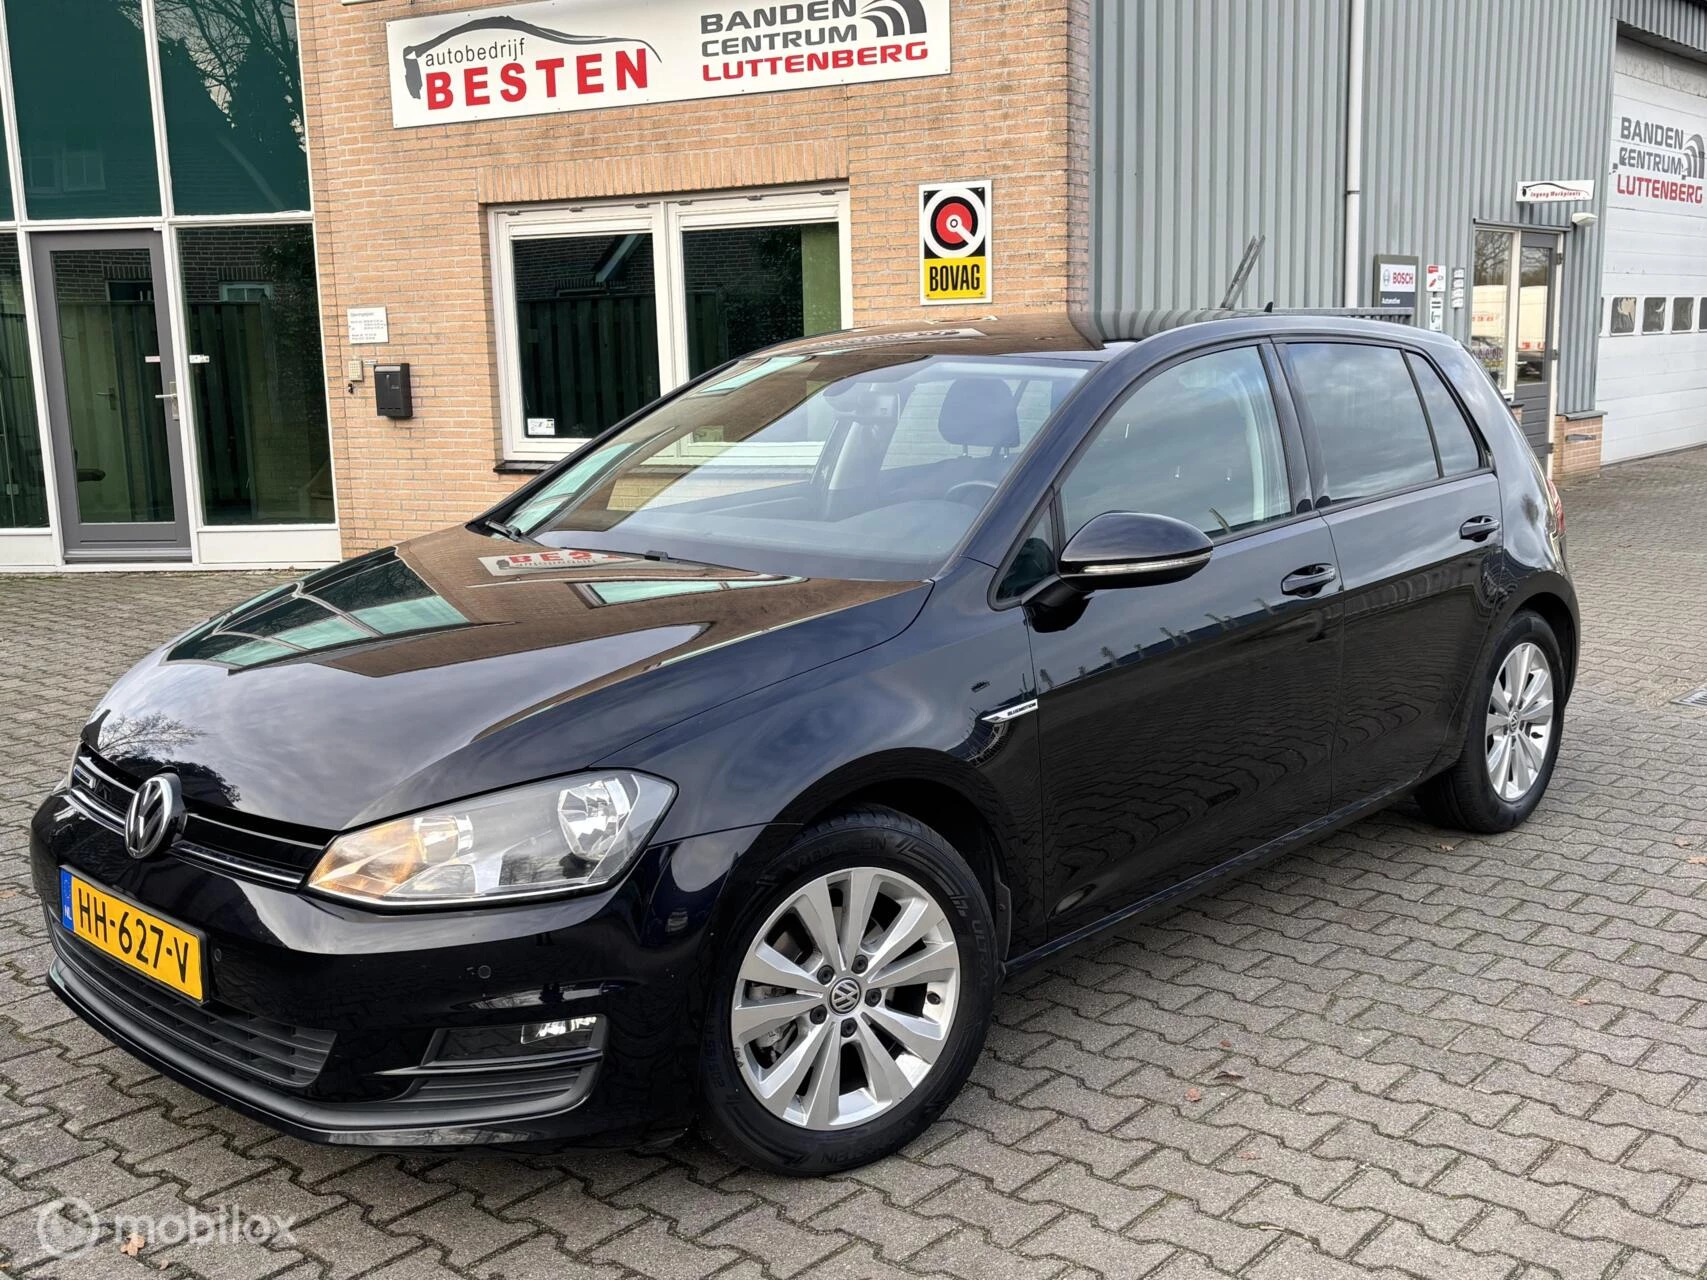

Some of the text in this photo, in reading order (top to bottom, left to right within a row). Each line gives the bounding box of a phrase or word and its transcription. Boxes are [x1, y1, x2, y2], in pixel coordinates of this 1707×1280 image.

[701, 0, 857, 34] BANDEN
[425, 38, 525, 67] autobedrijf
[701, 24, 857, 57] CENTRUM
[702, 41, 929, 82] LUTTENBERG
[426, 48, 648, 110] BESTEN
[1620, 116, 1684, 150] BANDEN
[1619, 147, 1682, 175] CENTRUM
[1617, 174, 1703, 204] LUTTENBERG
[929, 264, 980, 292] BOVAG
[1392, 272, 1414, 284] BOSCH
[78, 888, 189, 984] HH-627-V
